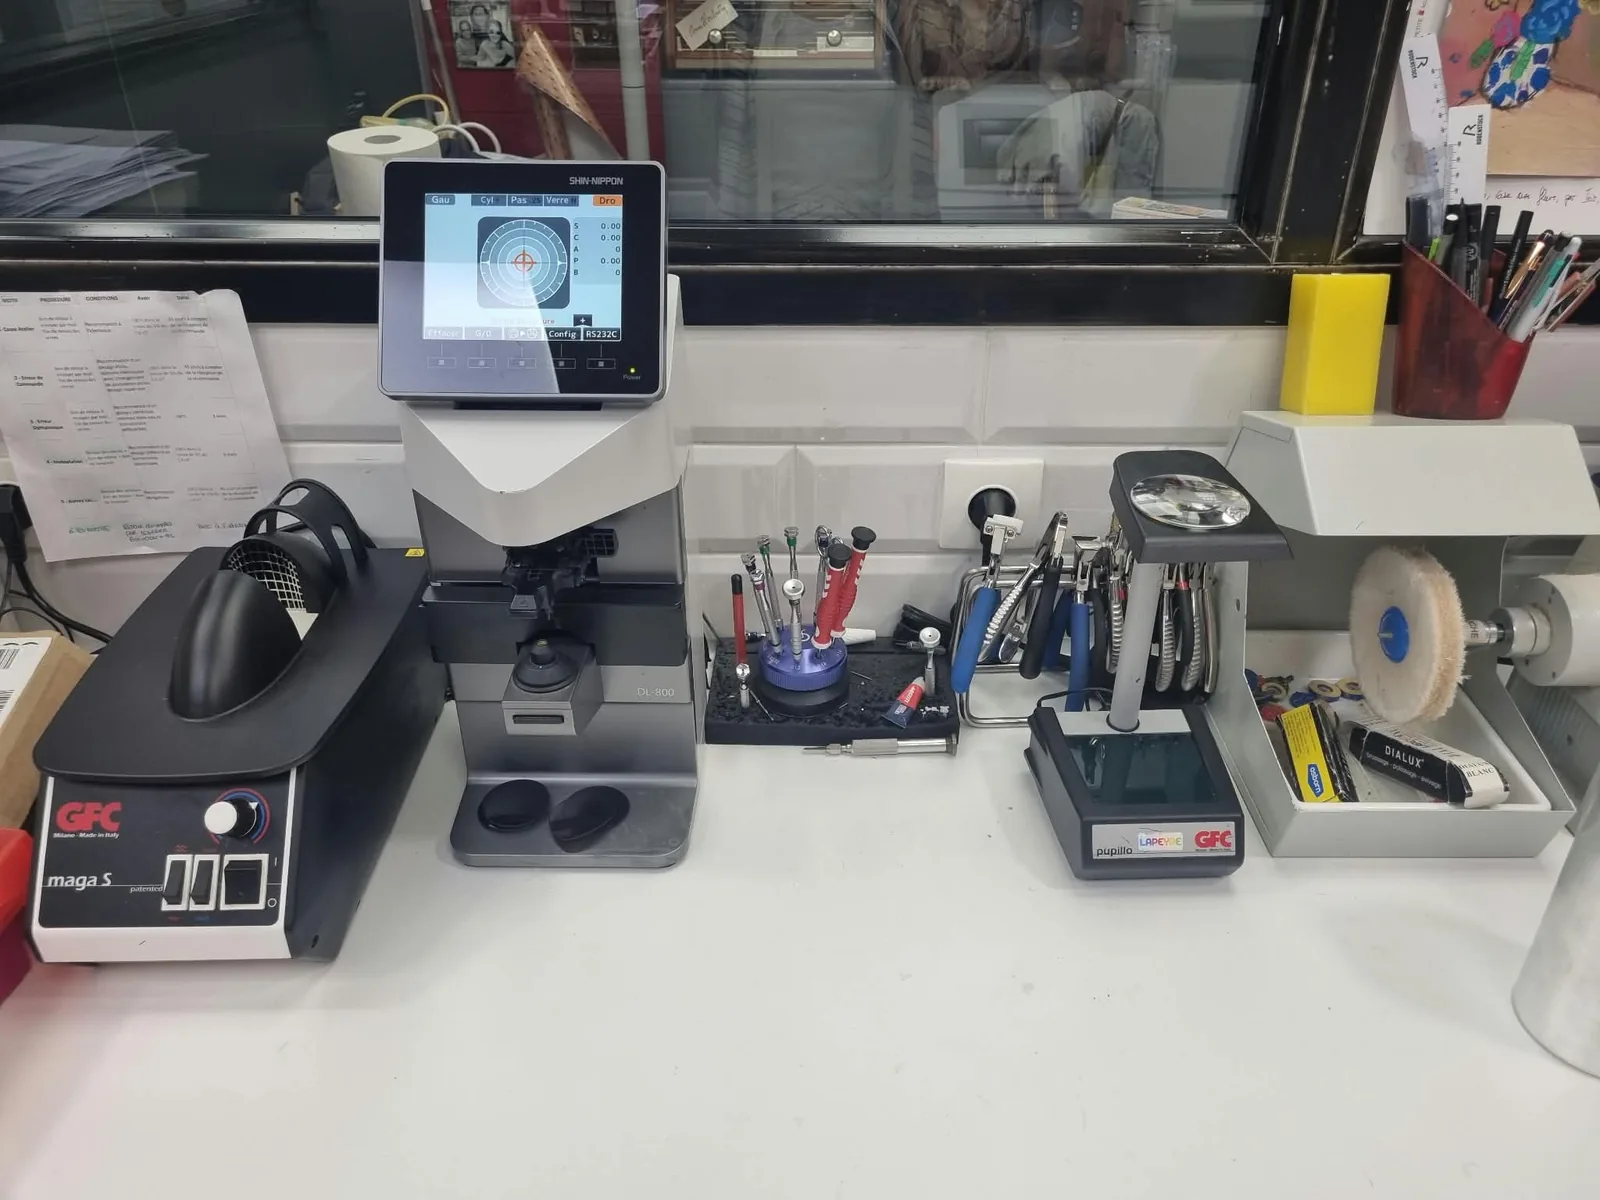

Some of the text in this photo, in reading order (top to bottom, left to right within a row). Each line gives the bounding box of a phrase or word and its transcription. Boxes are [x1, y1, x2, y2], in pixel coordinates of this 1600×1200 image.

[1415, 56, 1429, 69] R
[1462, 124, 1477, 137] R
[569, 176, 624, 186] SHIN-NIPPON
[431, 196, 450, 204] Gau
[480, 197, 494, 206] Cyl
[511, 196, 527, 204] Pas
[546, 196, 569, 204] Verre
[599, 197, 616, 205] Dro
[548, 330, 577, 340] Config
[586, 330, 618, 338] RS232C
[636, 687, 675, 697] DL-800
[1384, 745, 1422, 769] DIALUX
[1466, 767, 1495, 779] BLANC
[1309, 766, 1321, 794] osborn
[56, 801, 122, 832] GFC
[105, 832, 120, 841] Italy
[1194, 830, 1232, 849] GFC
[1139, 837, 1182, 847] LAPEYRE
[1096, 846, 1133, 857] pupillo
[48, 872, 112, 891] maga S
[129, 886, 164, 894] patented
